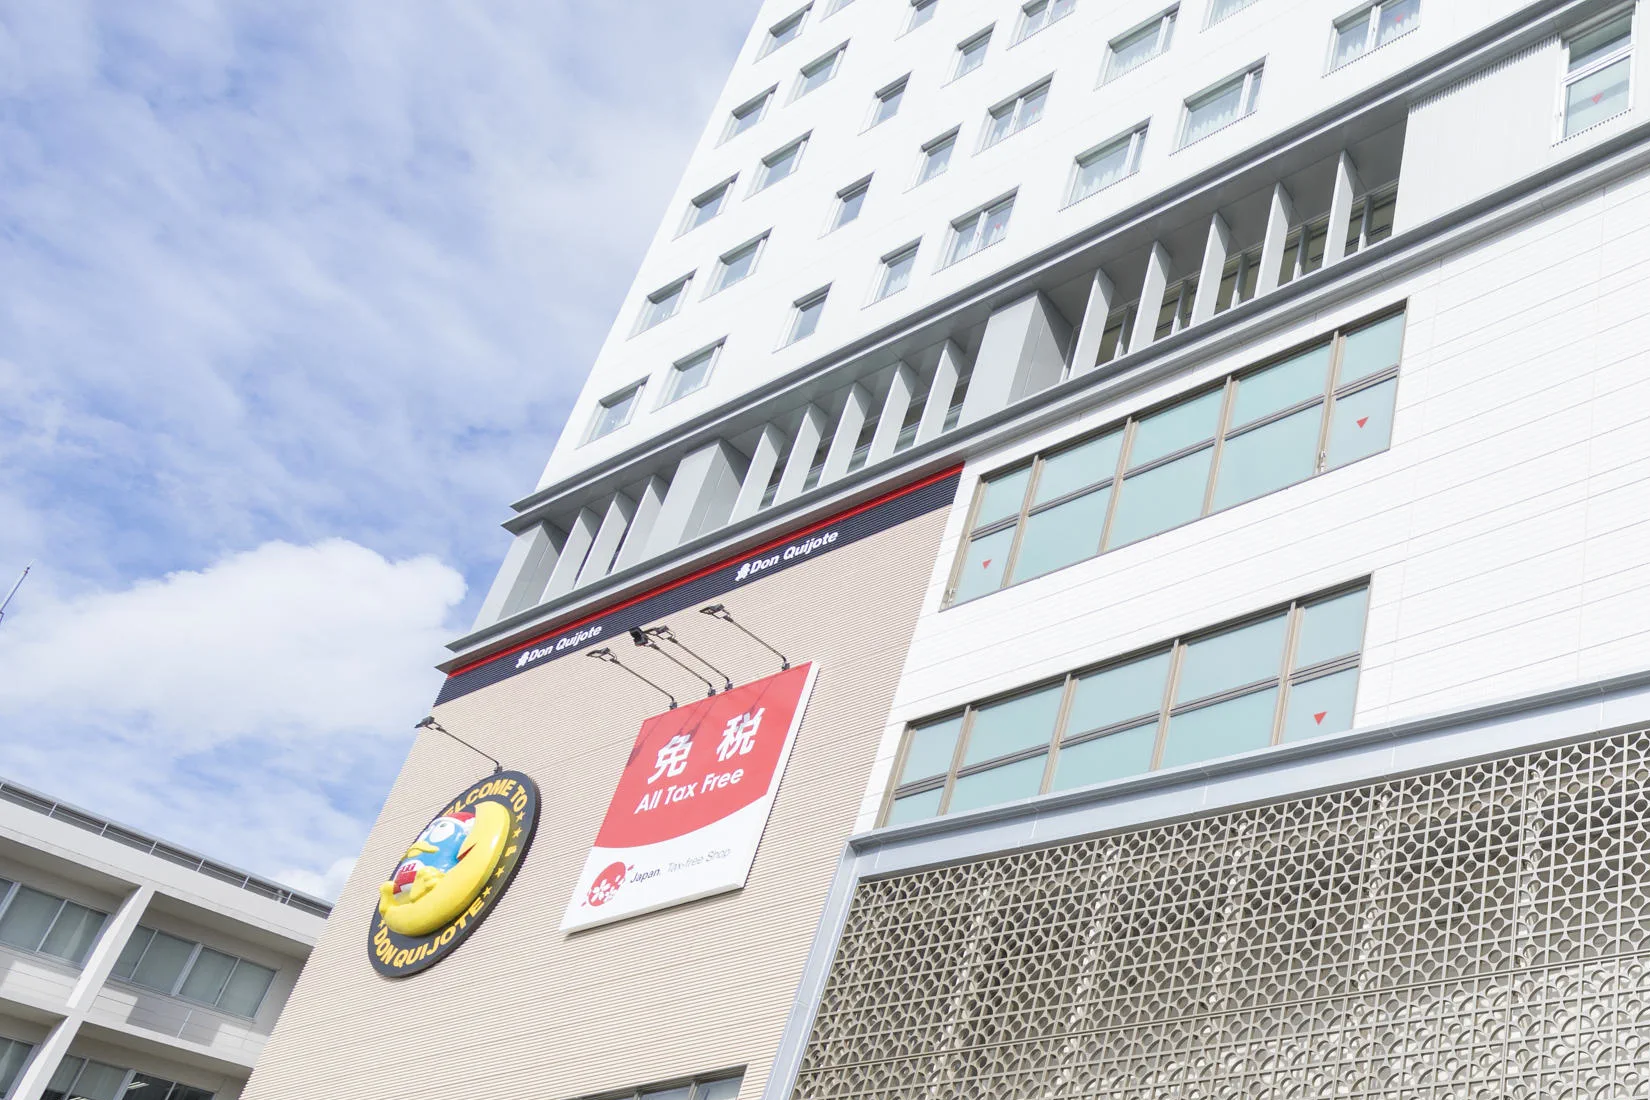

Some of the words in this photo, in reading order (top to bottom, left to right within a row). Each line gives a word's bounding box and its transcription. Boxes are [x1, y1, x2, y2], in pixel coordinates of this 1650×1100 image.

[749, 555, 780, 574] Don
[783, 532, 838, 560] Quijote
[528, 645, 553, 662] Don
[556, 626, 602, 650] Quijote
[648, 707, 766, 785] 免税
[441, 778, 517, 817] ELCOME
[510, 784, 528, 813] TO
[633, 789, 663, 815] All
[664, 782, 698, 805] Tax
[700, 768, 744, 794] Free
[374, 927, 398, 965] DON
[393, 897, 485, 968] QUIJOTE
